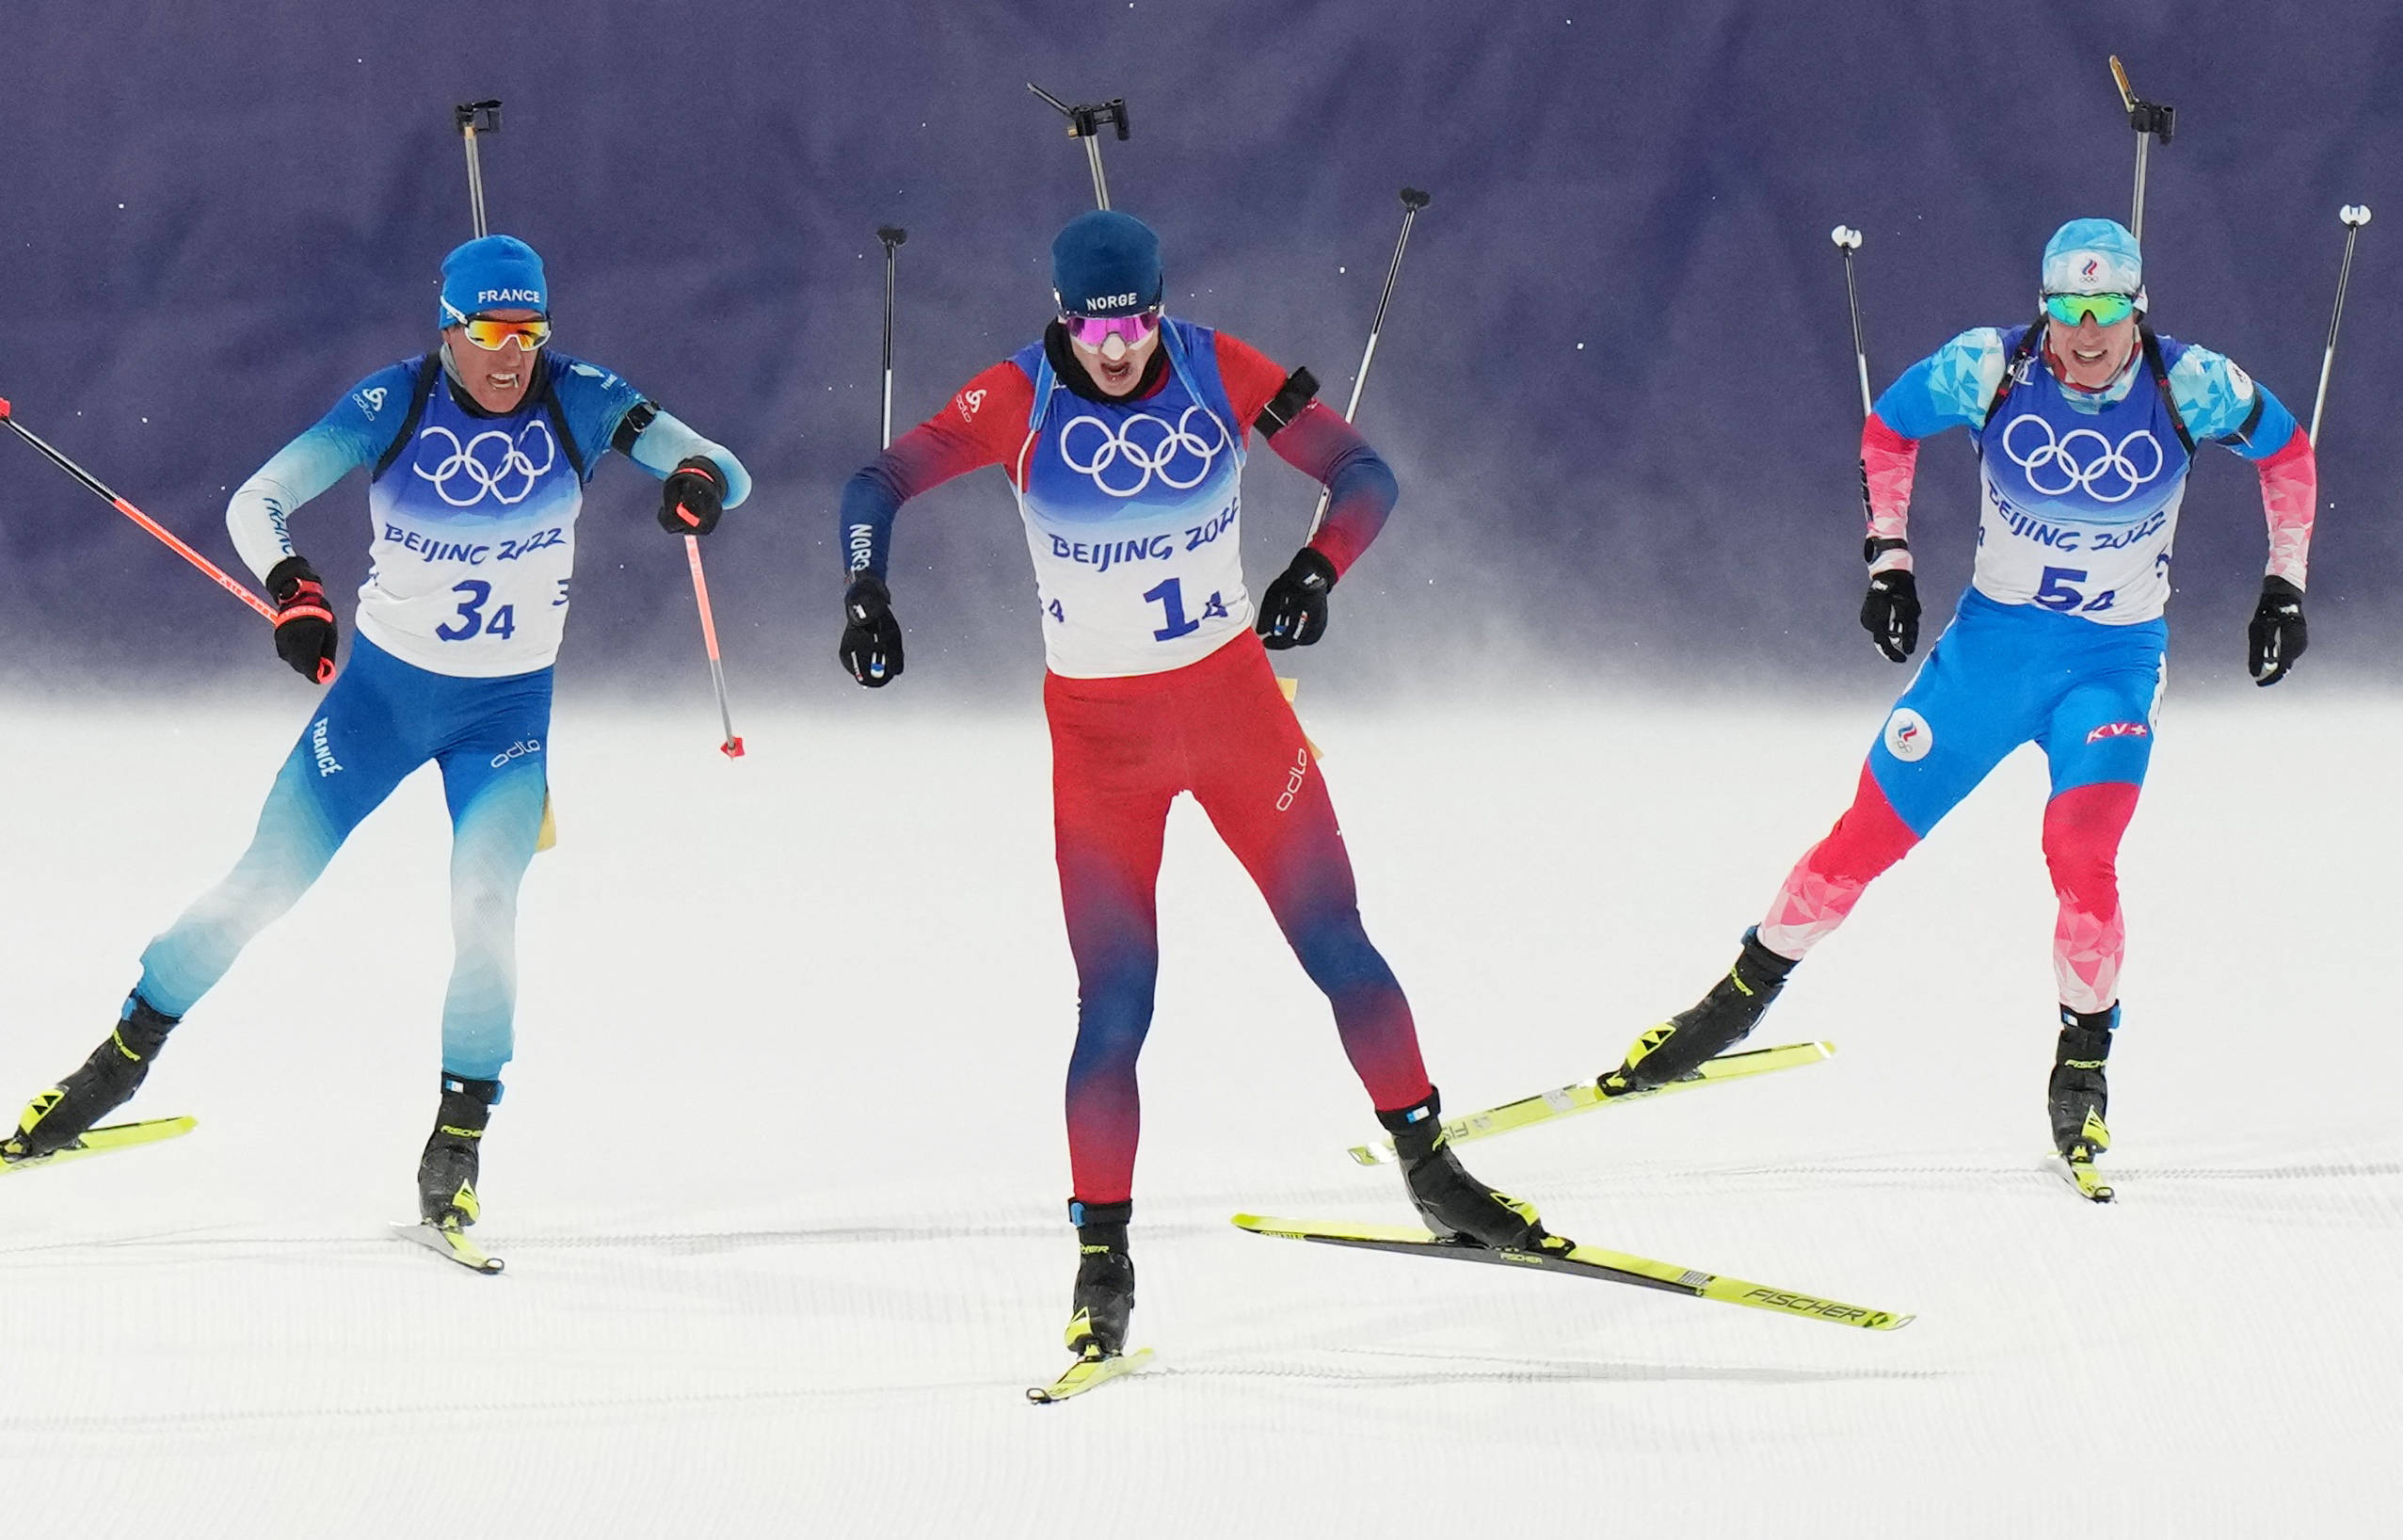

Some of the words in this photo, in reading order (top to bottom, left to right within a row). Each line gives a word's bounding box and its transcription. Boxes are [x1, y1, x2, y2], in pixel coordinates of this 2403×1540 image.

[477, 288, 540, 304] FRANCE
[1085, 292, 1138, 312] NORGE
[384, 521, 489, 566] BEIJING
[1048, 534, 1174, 573] BEIJING
[312, 716, 344, 778] FRANCE
[490, 738, 542, 769] odlo
[1275, 747, 1307, 812] odlo
[1741, 1288, 1866, 1323] FISCHER
